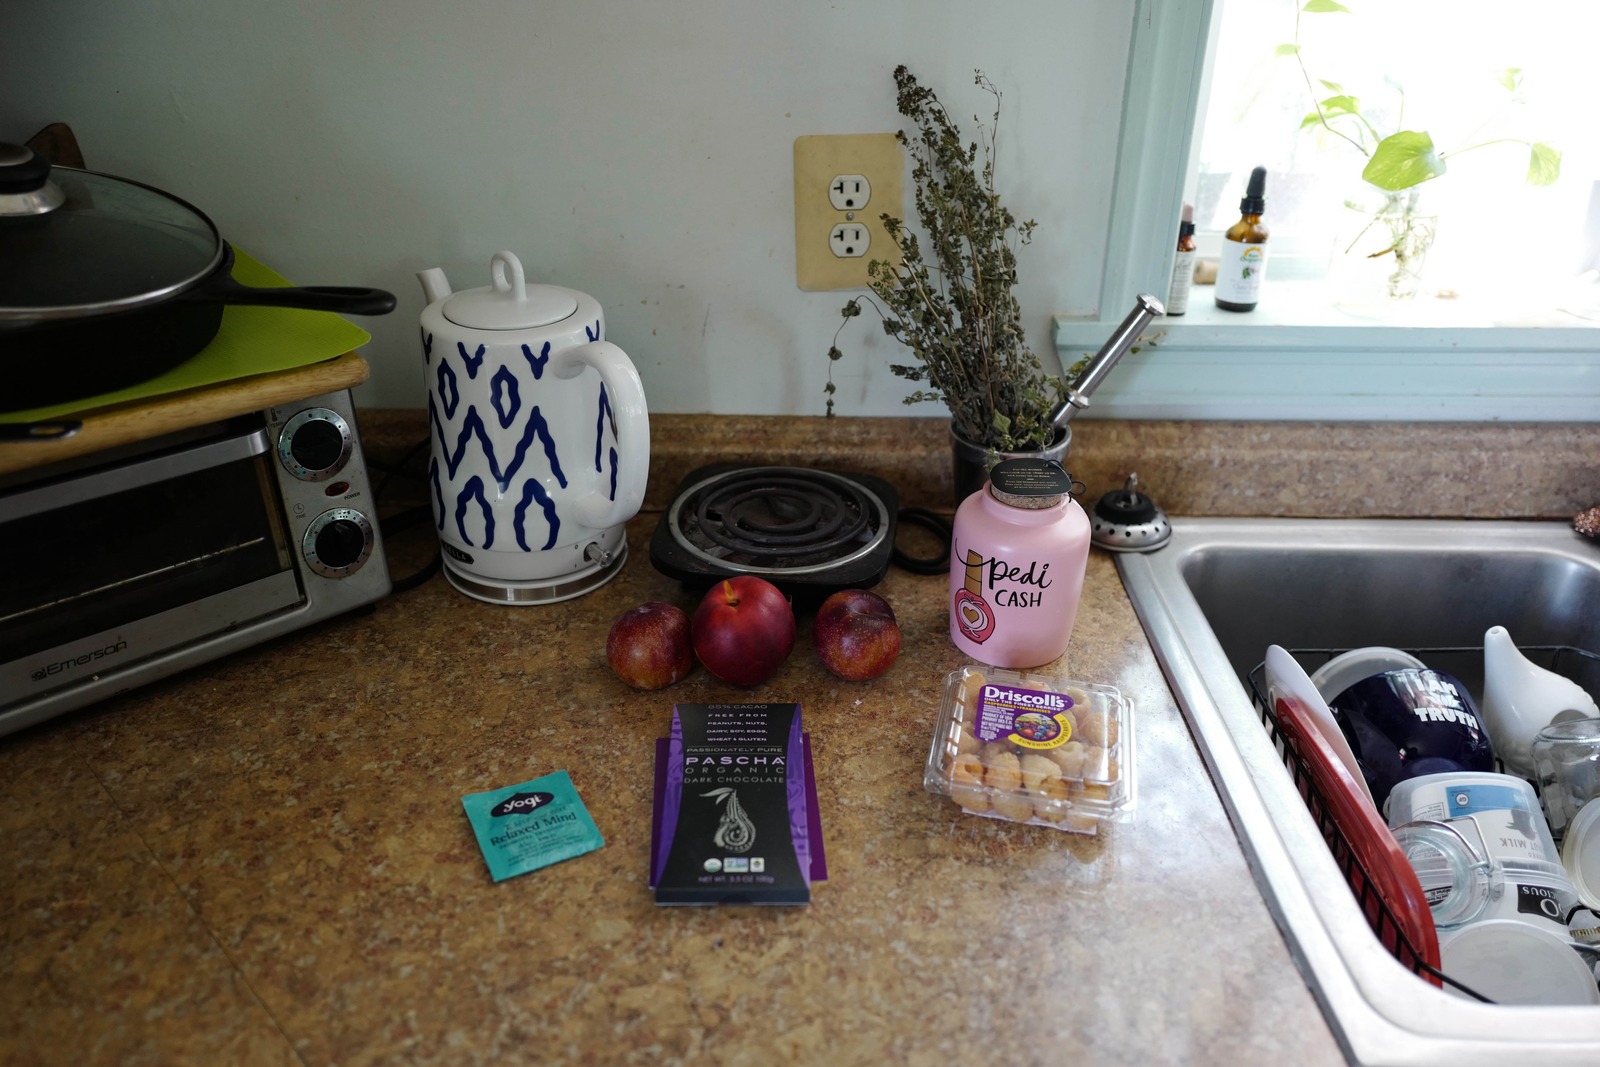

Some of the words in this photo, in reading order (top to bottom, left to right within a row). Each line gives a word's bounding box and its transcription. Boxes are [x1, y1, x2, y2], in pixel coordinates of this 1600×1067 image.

[344, 491, 361, 500] POWER
[970, 549, 1053, 590] pedi
[994, 589, 1043, 608] CASH
[46, 640, 128, 676] Emerson
[984, 686, 1065, 708] Driscoll's
[1427, 680, 1459, 697] AM
[1413, 707, 1479, 730] TRUTH
[1019, 737, 1052, 747] SUNSHINE
[684, 766, 785, 774] ORGANIC
[685, 756, 785, 766] PASCHA
[717, 776, 784, 784] CHOCOLATE
[503, 794, 542, 813] yogi
[489, 821, 541, 847] Relaxed
[543, 811, 577, 827] Mind
[1499, 837, 1527, 849] MILK
